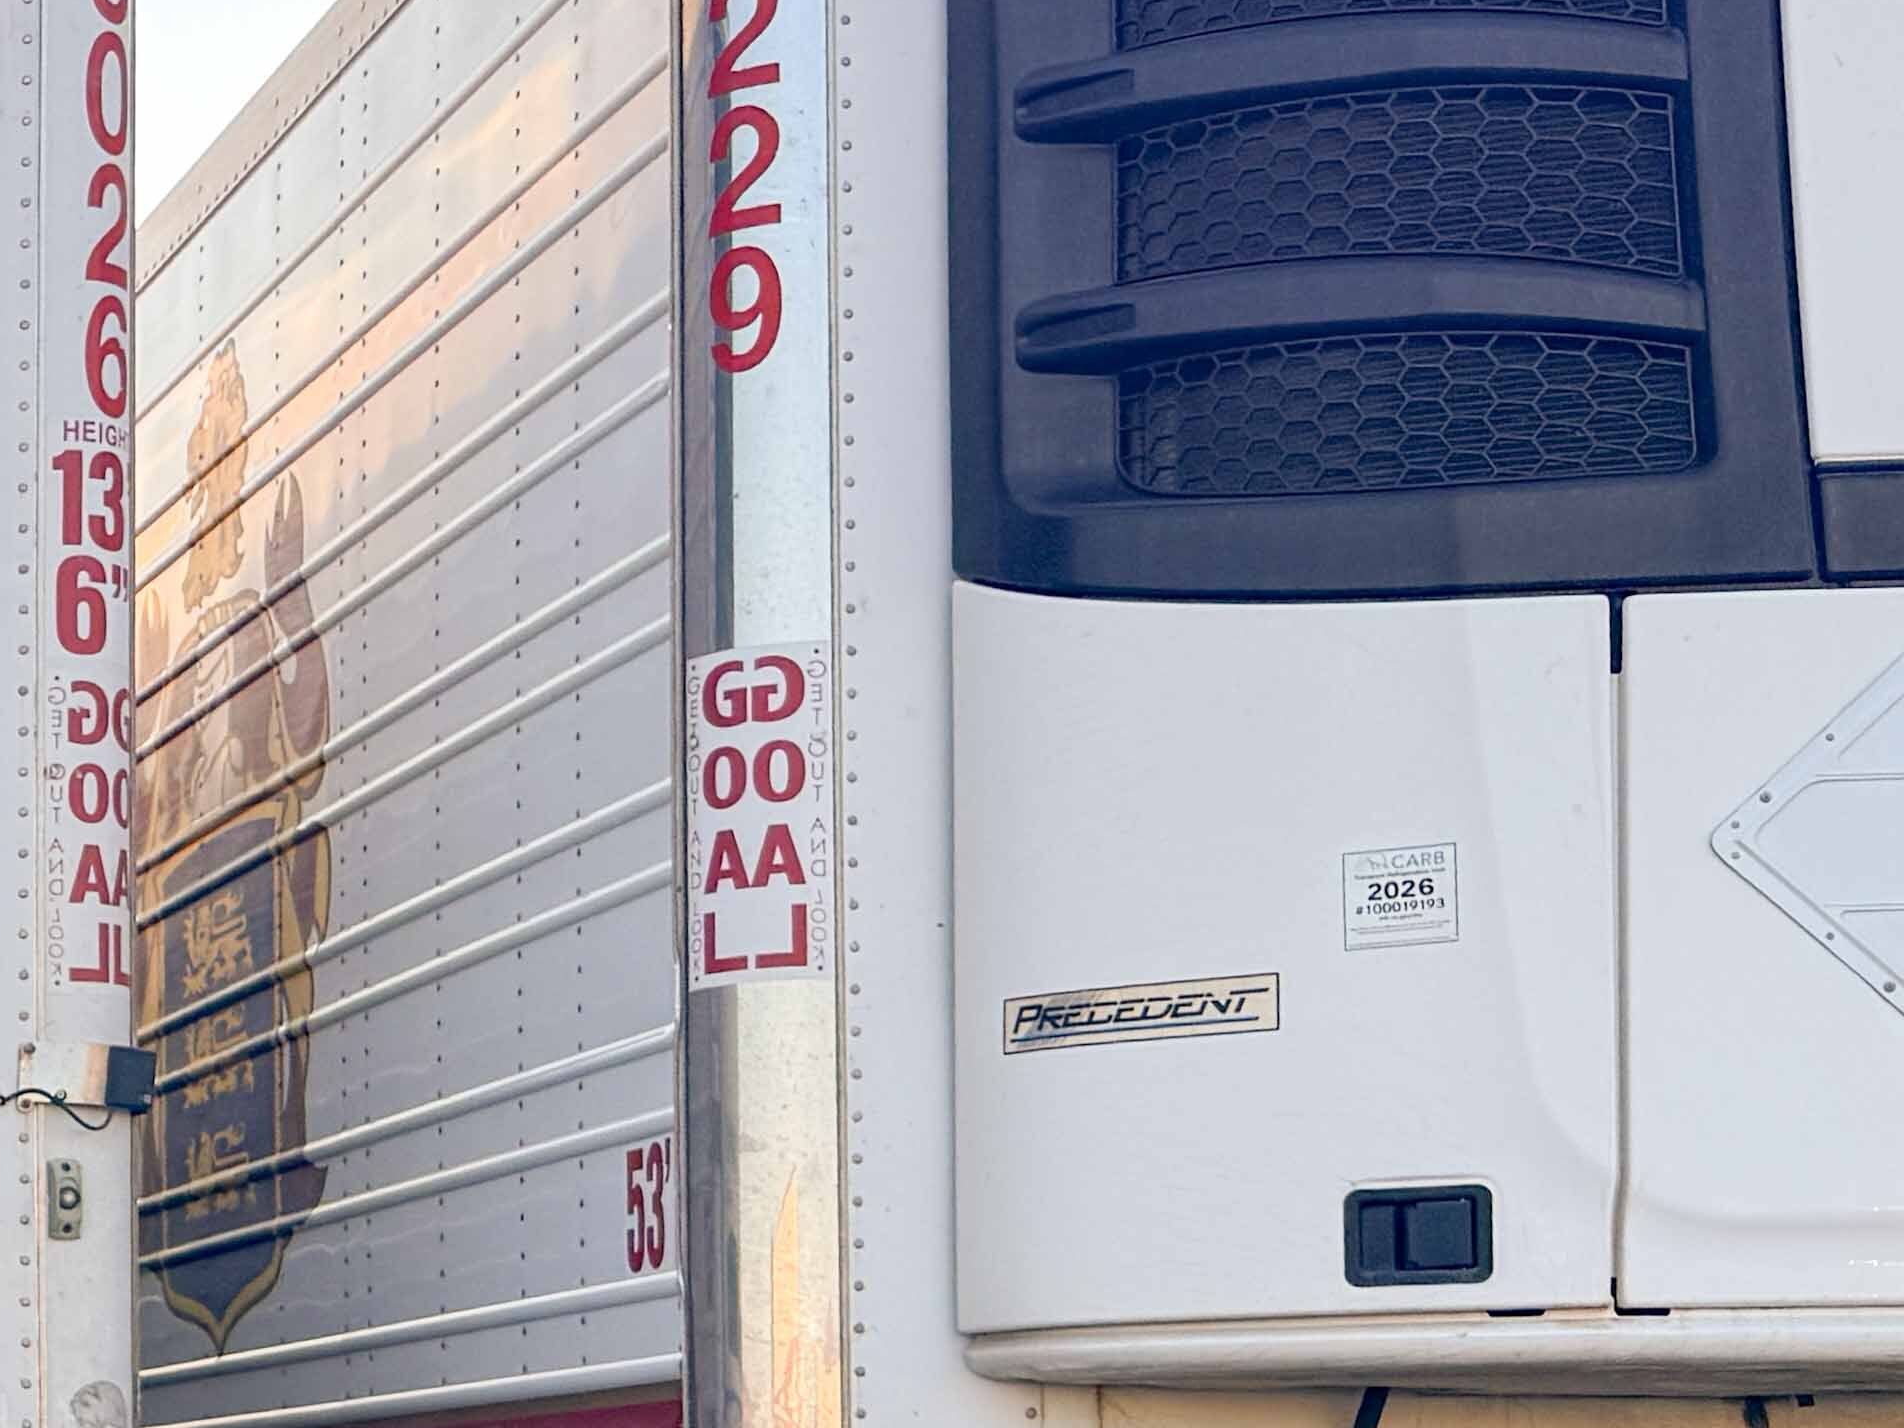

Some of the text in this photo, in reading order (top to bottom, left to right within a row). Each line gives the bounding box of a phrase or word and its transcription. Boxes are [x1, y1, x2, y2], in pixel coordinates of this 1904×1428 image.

[702, 659, 748, 975] GOAL
[1392, 851, 1445, 868] CARB
[1368, 878, 1434, 901] 2026
[1013, 988, 1269, 1034] PRECEDENT
[626, 1137, 670, 1273] 53'
